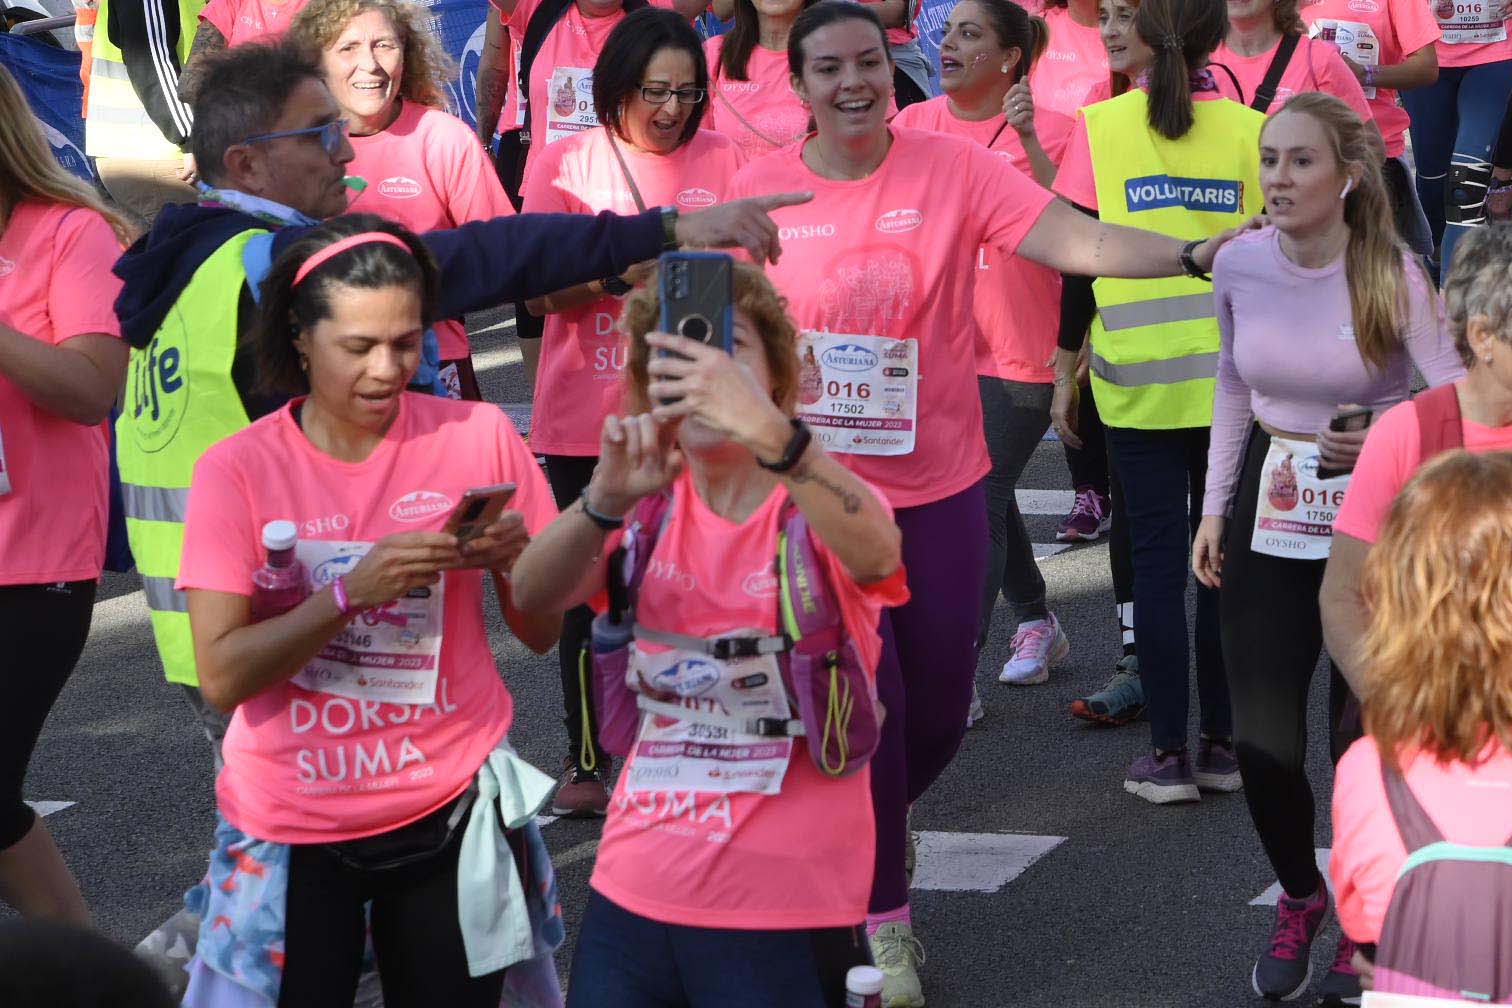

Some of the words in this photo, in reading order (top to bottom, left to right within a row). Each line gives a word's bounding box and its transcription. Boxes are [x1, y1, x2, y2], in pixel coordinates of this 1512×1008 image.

[1456, 4, 1482, 14] 016
[779, 223, 835, 241] OYSHO
[827, 380, 871, 399] 016
[830, 403, 865, 415] 17502
[1301, 488, 1344, 506] 016
[1265, 537, 1307, 550] OYSHO
[296, 736, 427, 784] SUMA
